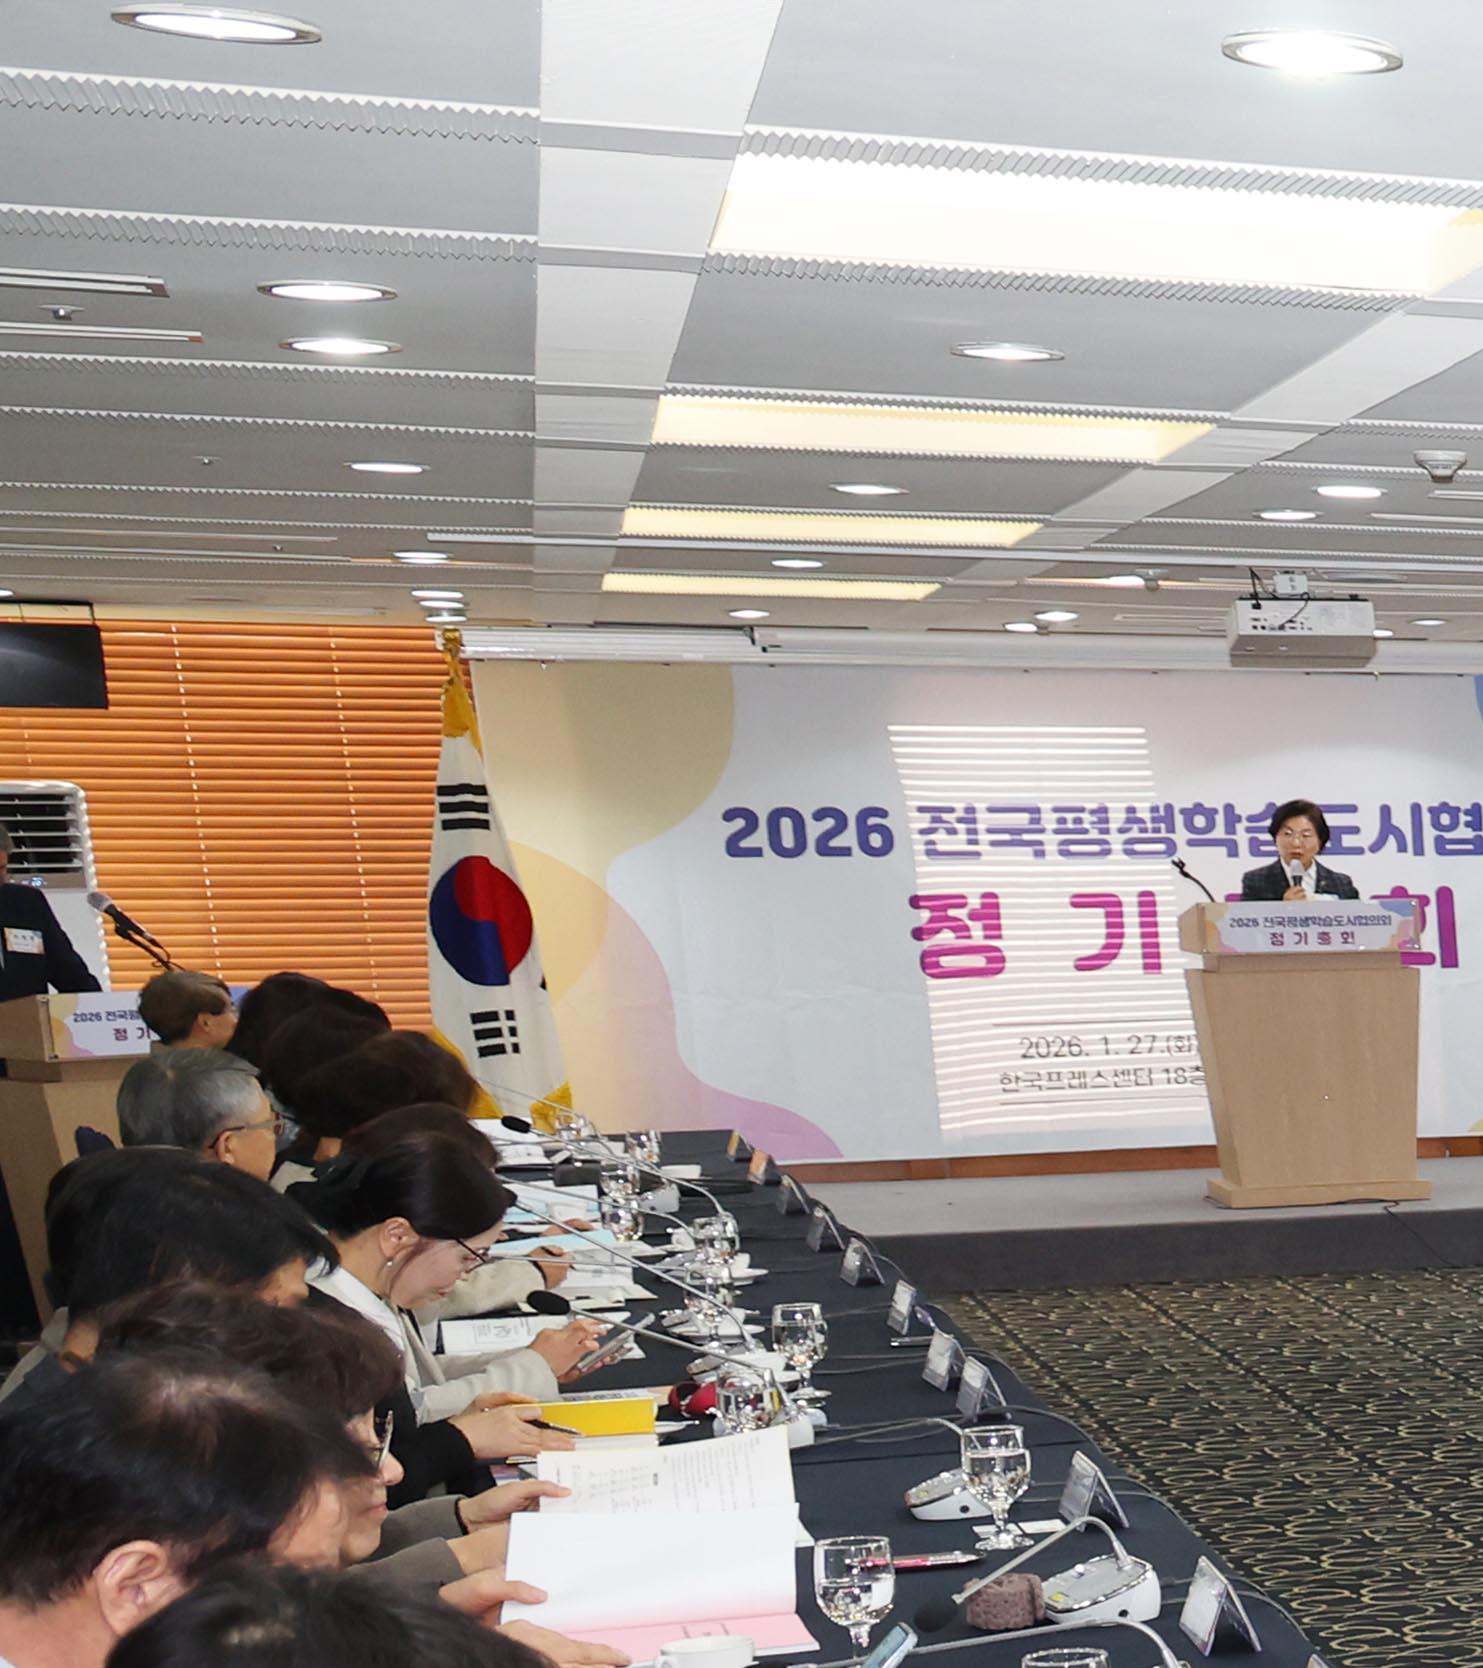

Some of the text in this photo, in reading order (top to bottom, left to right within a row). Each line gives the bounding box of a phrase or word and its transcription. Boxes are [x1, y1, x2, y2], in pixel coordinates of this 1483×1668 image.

[721, 806, 895, 858] 2026
[908, 892, 1006, 979] 정
[1069, 890, 1162, 975] 기
[73, 1012, 103, 1023] 2026
[1019, 1035, 1090, 1059] 2026.
[1101, 1036, 1119, 1056] 1.
[1000, 1068, 1153, 1093] 한국프레스센터
